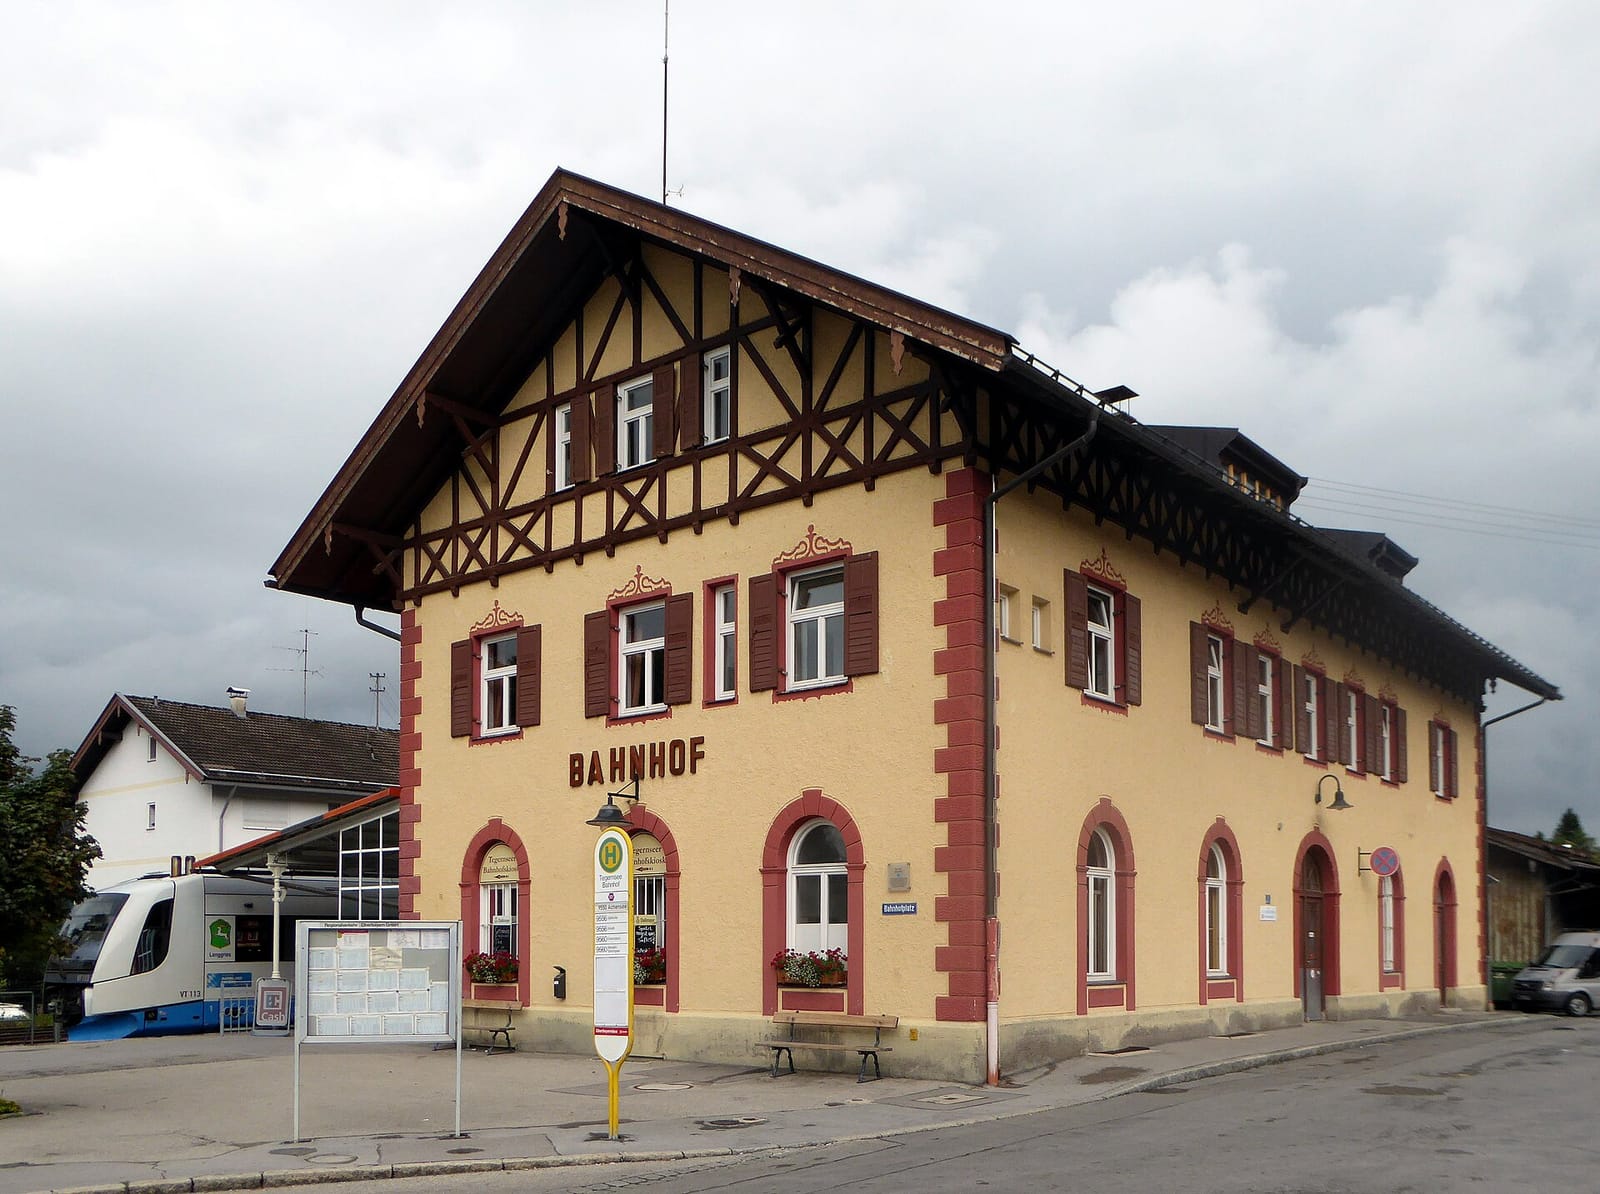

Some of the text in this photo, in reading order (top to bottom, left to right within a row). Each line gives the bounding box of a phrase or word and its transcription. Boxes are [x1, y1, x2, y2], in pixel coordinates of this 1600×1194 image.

[569, 736, 705, 787] BAHNHOF
[605, 845, 617, 864] H
[633, 846, 661, 856] egernseer
[488, 856, 516, 864] Tegernseer
[600, 874, 622, 882] Tegernsee
[261, 1011, 285, 1021] Cash
